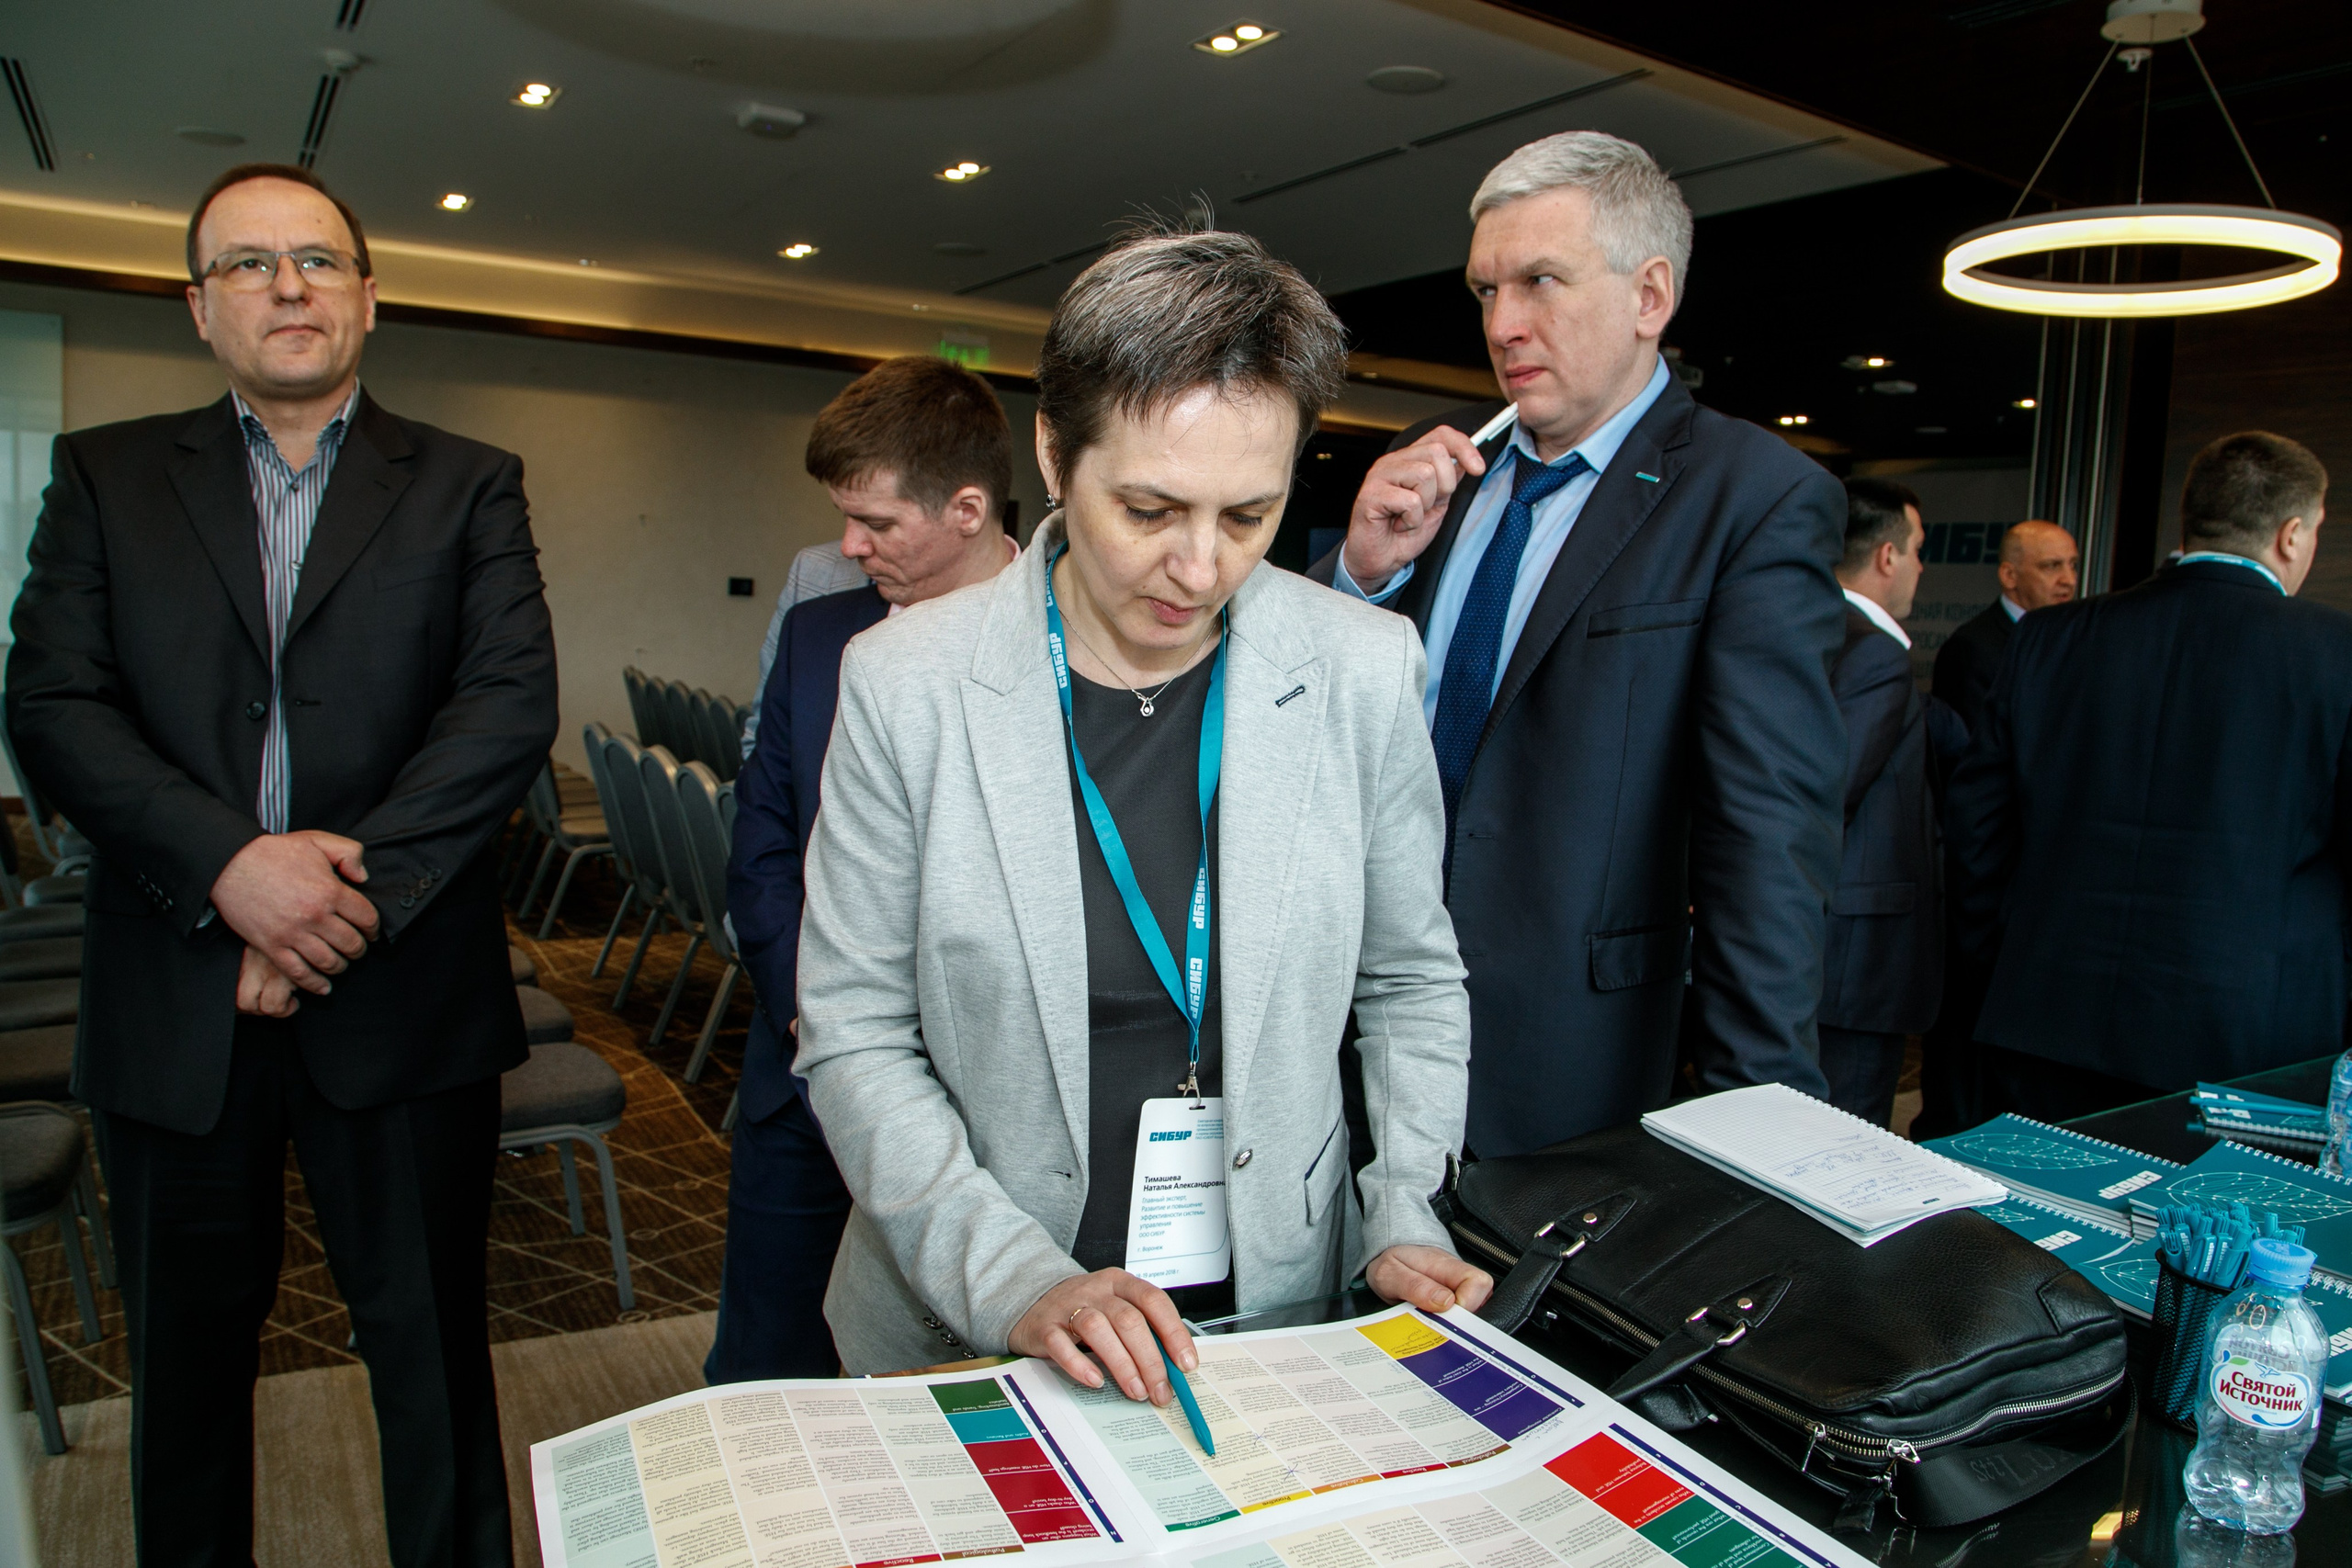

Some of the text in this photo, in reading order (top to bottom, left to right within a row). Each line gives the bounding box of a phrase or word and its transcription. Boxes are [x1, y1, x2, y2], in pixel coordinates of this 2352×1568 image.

[1049, 633, 1068, 689] СИБУР
[1193, 868, 1206, 930] СИБУР
[1190, 957, 1203, 1020] СИБУР
[1149, 1131, 1193, 1142] СИБУР
[1143, 1183, 1172, 1191] Наталья
[2098, 1170, 2163, 1200] СИБУР
[1142, 1194, 1187, 1203] Главный эксперт,
[1140, 1212, 1182, 1221] эффективности
[1139, 1221, 1171, 1230] управления
[2033, 1230, 2083, 1251] СИБ
[1462, 1450, 1496, 1465] Pathological
[1330, 1477, 1363, 1489] Calculative
[1262, 1495, 1291, 1506] Proactive
[1185, 1516, 1220, 1528] Generative
[961, 1547, 1005, 1557] Pathological
[881, 1556, 914, 1566] Reactive
